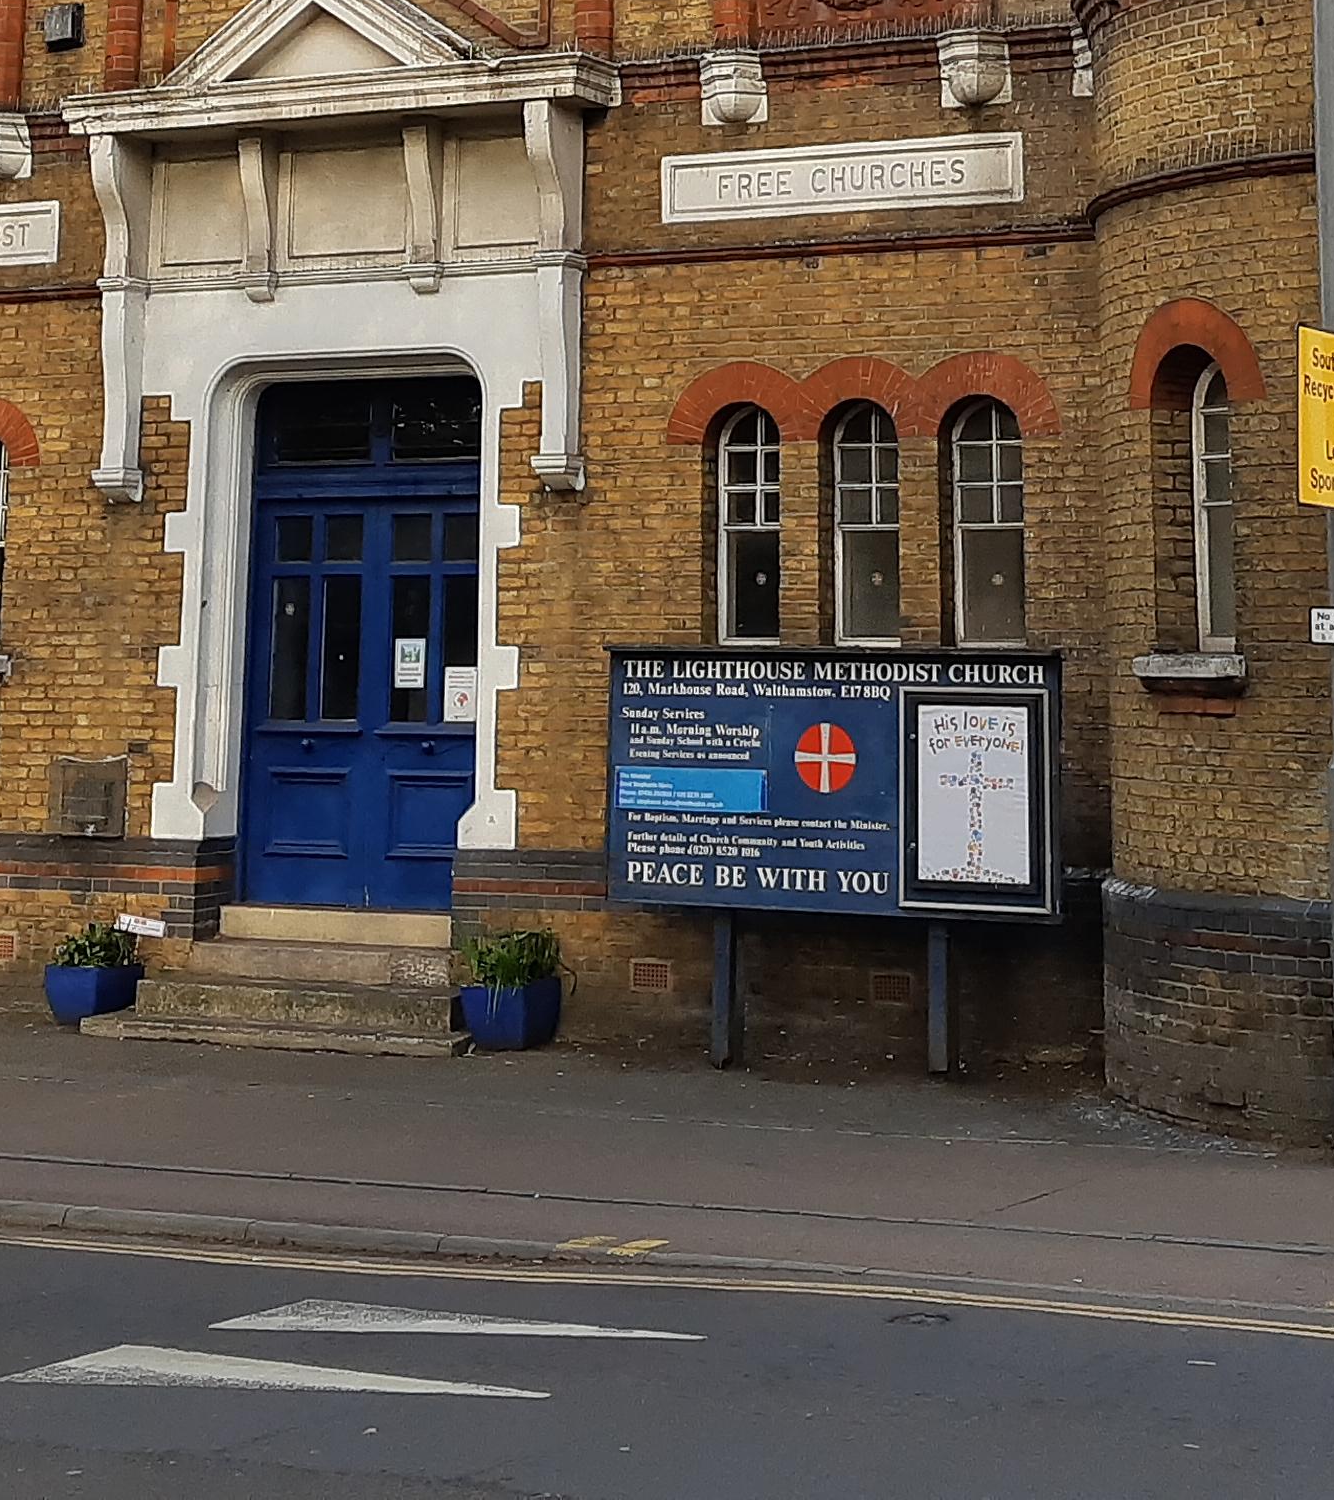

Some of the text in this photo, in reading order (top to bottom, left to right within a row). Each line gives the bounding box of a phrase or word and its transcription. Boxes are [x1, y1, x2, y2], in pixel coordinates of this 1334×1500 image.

[718, 159, 966, 199] FREE CHURCHES
[1316, 612, 1330, 620] No
[1315, 623, 1325, 631] at
[623, 660, 1045, 685] THE LIGHTHOUSE METHODIST CHURCH
[623, 682, 644, 697] 120,
[648, 682, 712, 696] Markhouse
[717, 683, 749, 697] Road,
[621, 707, 705, 721] Sunday Services
[666, 723, 712, 737] Morning
[715, 724, 760, 738] Worship
[934, 713, 958, 734] His
[1002, 716, 1016, 737] is
[629, 736, 644, 744] and
[646, 736, 674, 746] Sunday
[677, 736, 703, 746] School
[706, 737, 723, 746] with
[929, 737, 951, 755] for
[629, 748, 660, 759] Evening
[662, 749, 695, 759] Services
[628, 811, 642, 821] For
[681, 814, 719, 825] Marriage
[722, 815, 736, 825] and
[738, 816, 772, 826] Services
[774, 817, 800, 828] please
[801, 819, 831, 828] contact
[833, 819, 847, 829] the
[628, 831, 865, 850] Further details of Church Community and Youth Activities
[628, 842, 656, 853] Please
[659, 843, 685, 855] phone
[628, 861, 890, 894] PEACE BE WITH YOU
